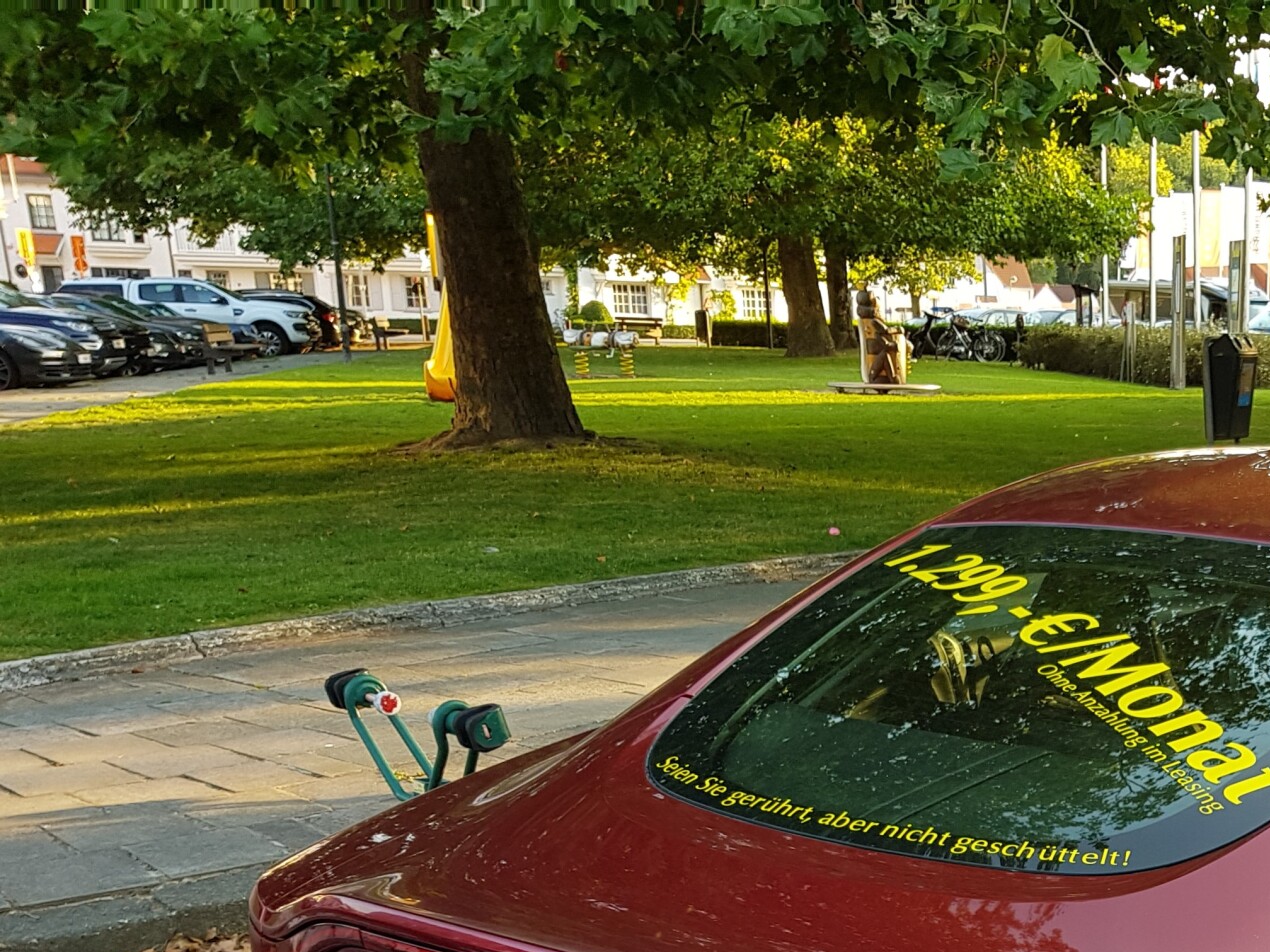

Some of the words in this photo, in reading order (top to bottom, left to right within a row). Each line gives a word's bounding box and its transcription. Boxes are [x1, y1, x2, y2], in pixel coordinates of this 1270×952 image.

[1037, 663, 1077, 692] Ohne
[1071, 690, 1148, 748] Anzahlung
[1141, 743, 1167, 763] im
[1162, 760, 1224, 815] Leasing
[656, 755, 699, 785] Seien
[695, 776, 727, 797] Sie
[720, 790, 814, 824] gerührt,
[818, 810, 880, 834] aber
[879, 823, 952, 847] nicht
[950, 836, 1132, 867] geschüttelt!
